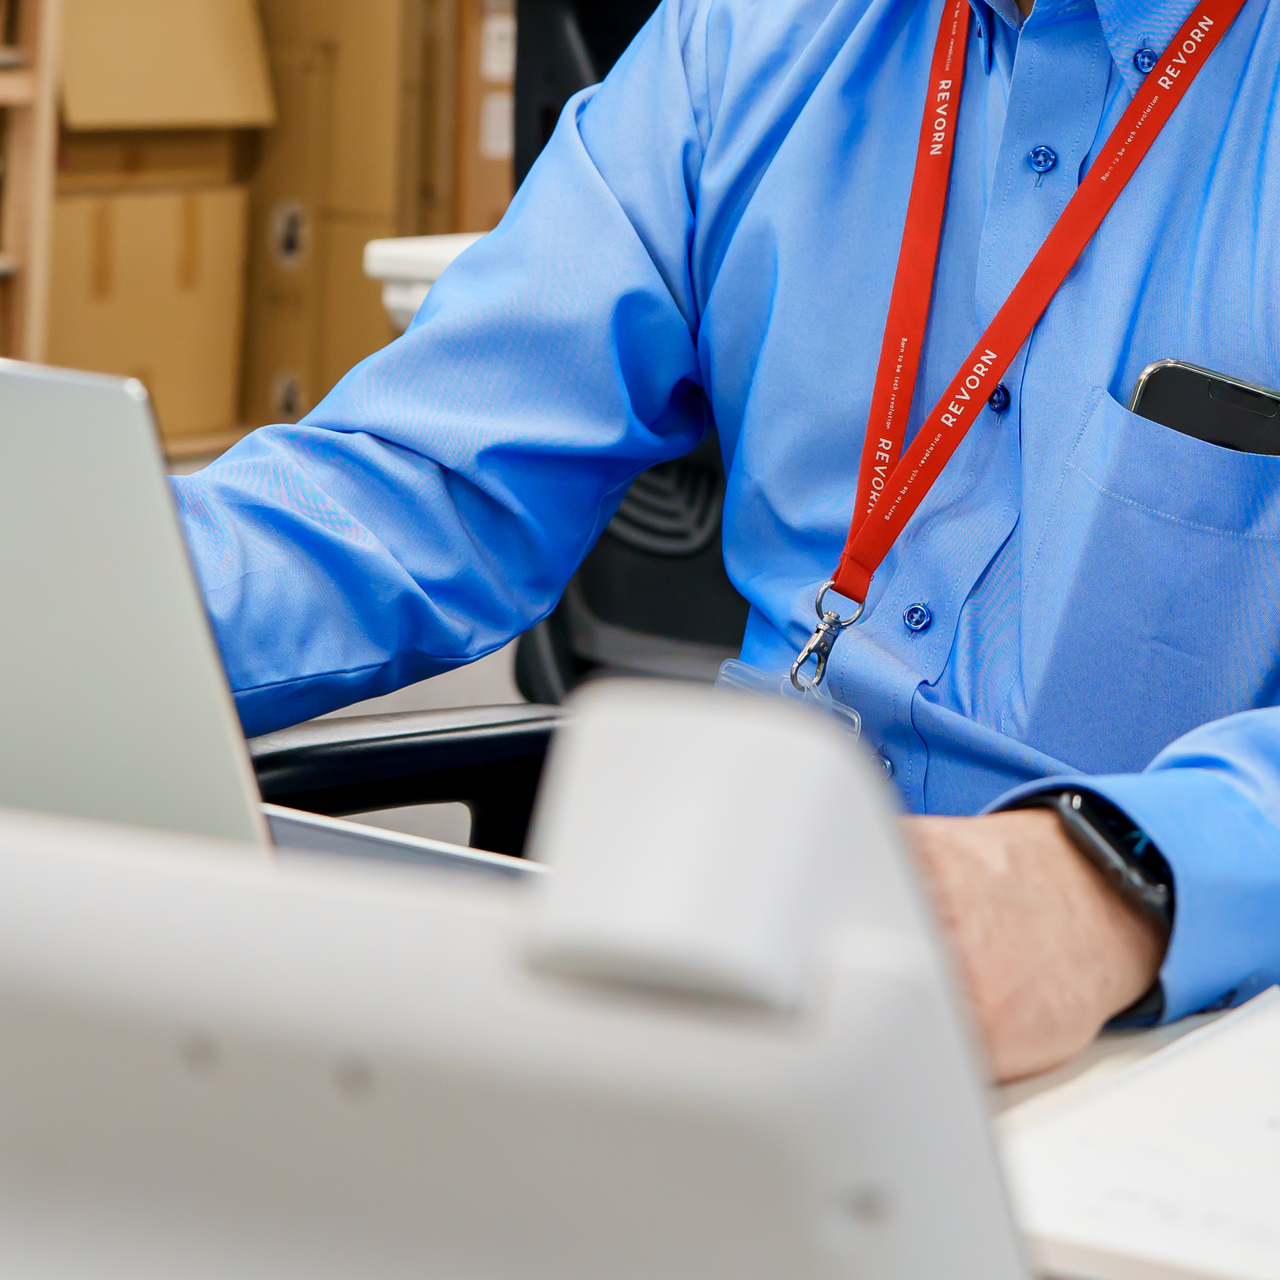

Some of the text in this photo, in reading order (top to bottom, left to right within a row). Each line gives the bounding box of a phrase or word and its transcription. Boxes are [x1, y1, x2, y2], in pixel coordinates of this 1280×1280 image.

[1157, 15, 1214, 90] REVORN
[929, 80, 952, 155] REVORN
[940, 349, 998, 428] REVORN
